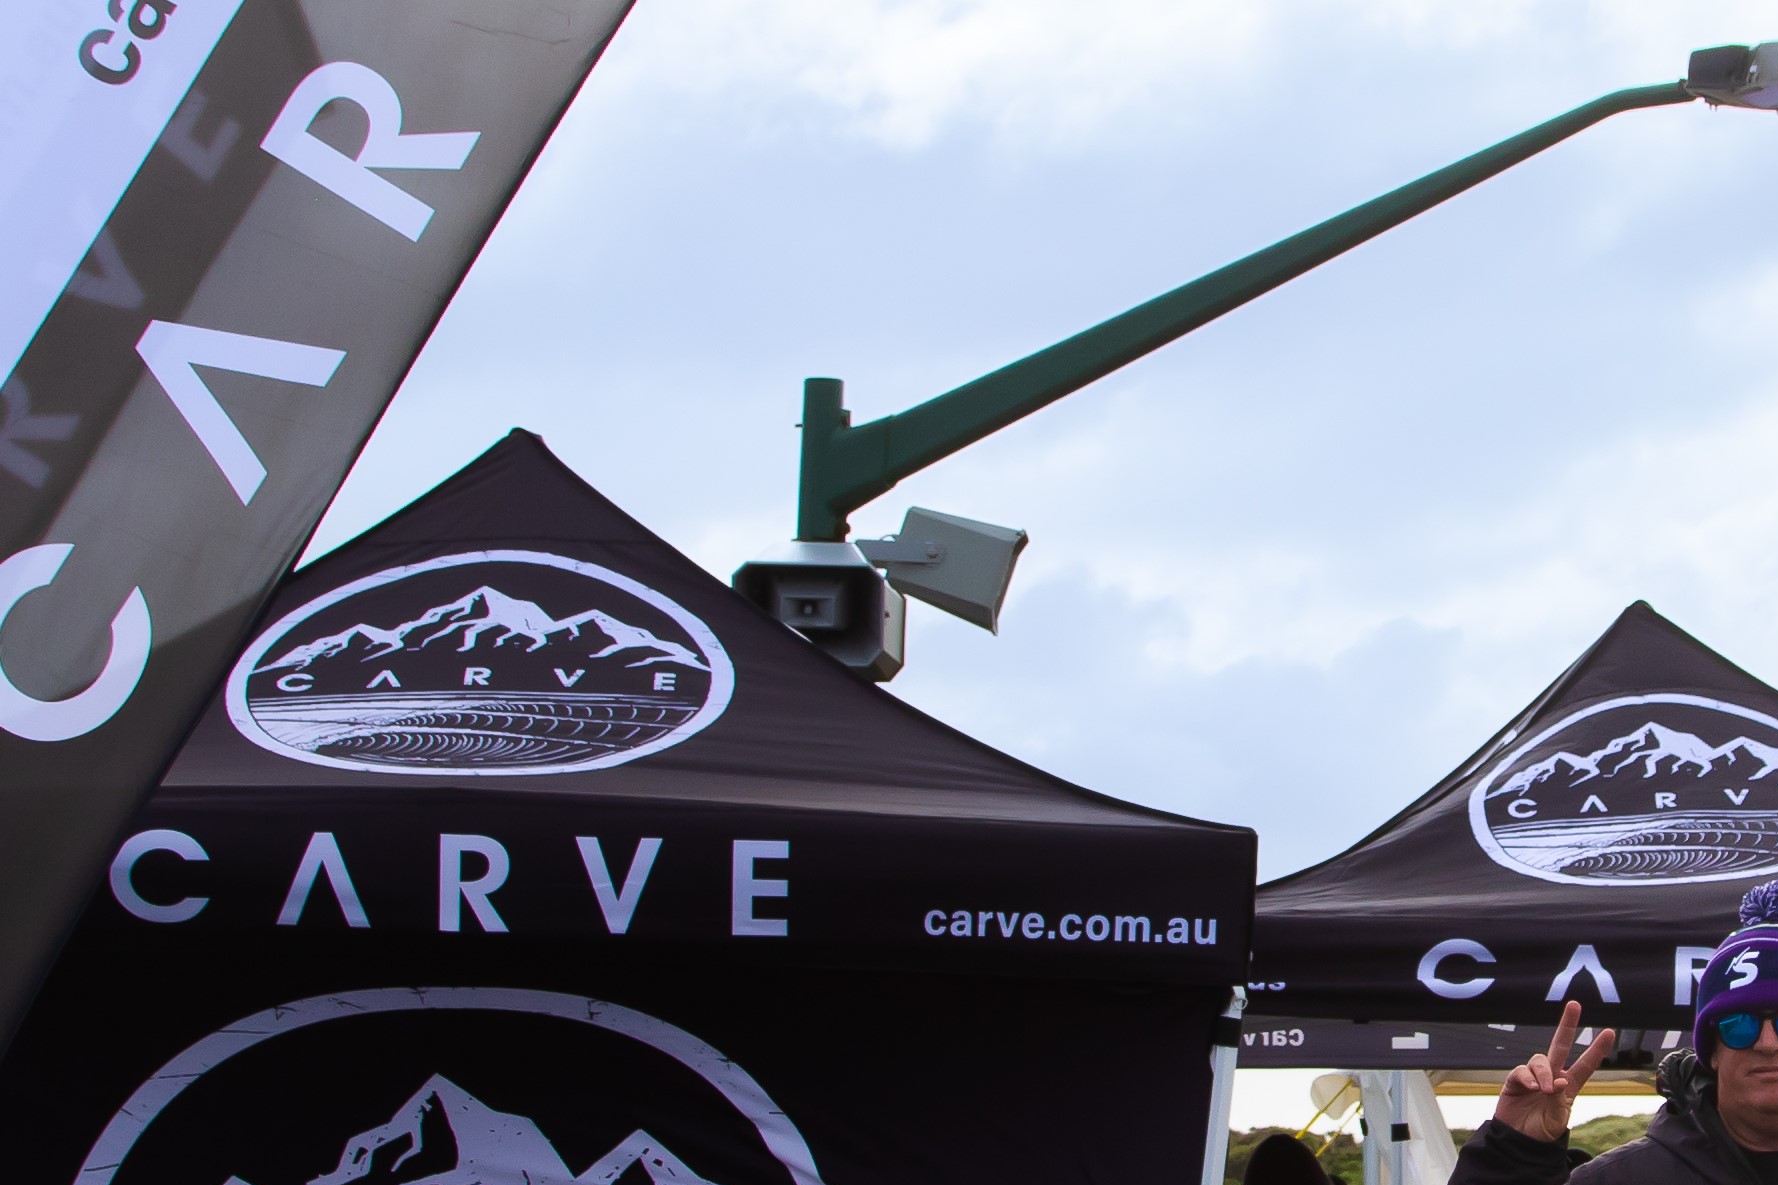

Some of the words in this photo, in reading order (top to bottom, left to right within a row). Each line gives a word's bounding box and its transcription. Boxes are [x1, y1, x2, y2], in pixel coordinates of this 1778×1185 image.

[276, 667, 677, 691] CARVE
[109, 829, 790, 936] CARVE
[924, 909, 1218, 945] carve.com.au
